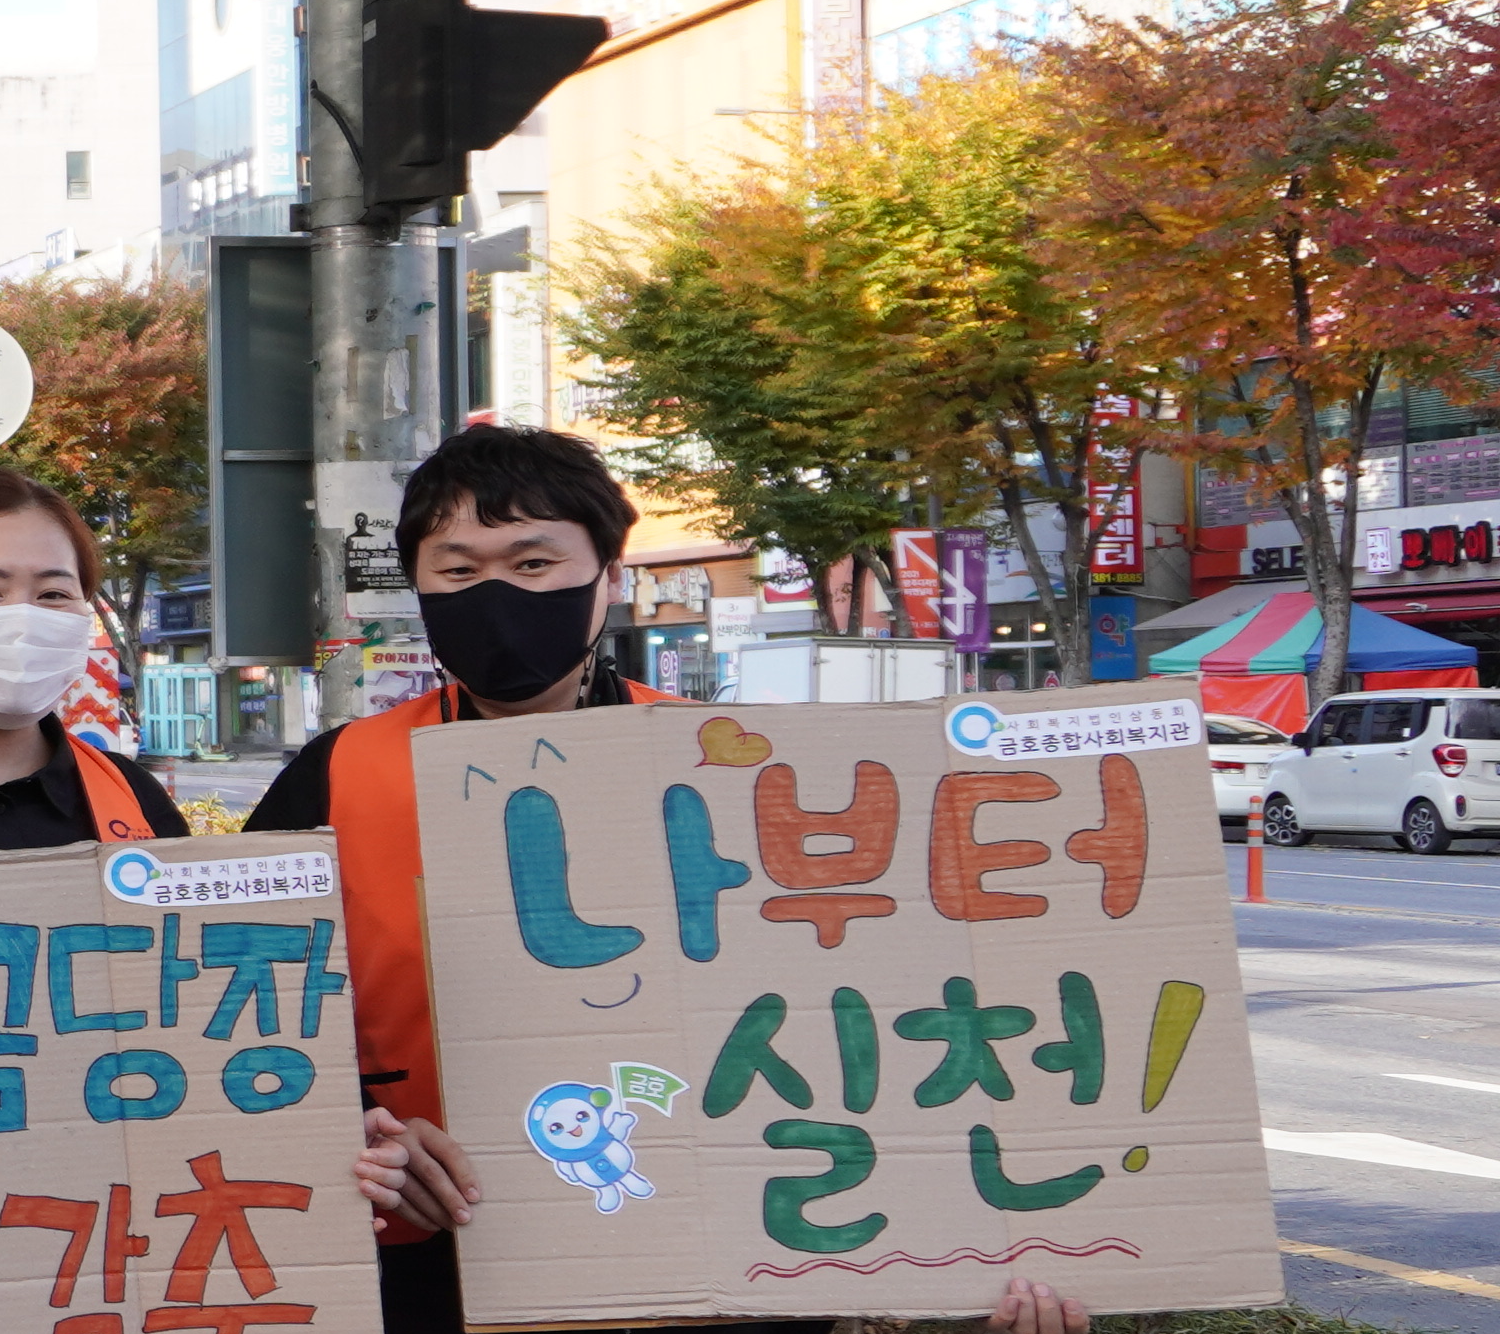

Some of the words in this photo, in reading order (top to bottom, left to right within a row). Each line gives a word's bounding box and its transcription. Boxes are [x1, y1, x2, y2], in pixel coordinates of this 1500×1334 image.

[998, 722, 1190, 757] 금호종합사회복지관
[503, 753, 1150, 970] 나부터
[153, 872, 331, 905] 금호종합사회복지관
[628, 1070, 666, 1098] 금호
[702, 970, 1205, 1255] 실천!
